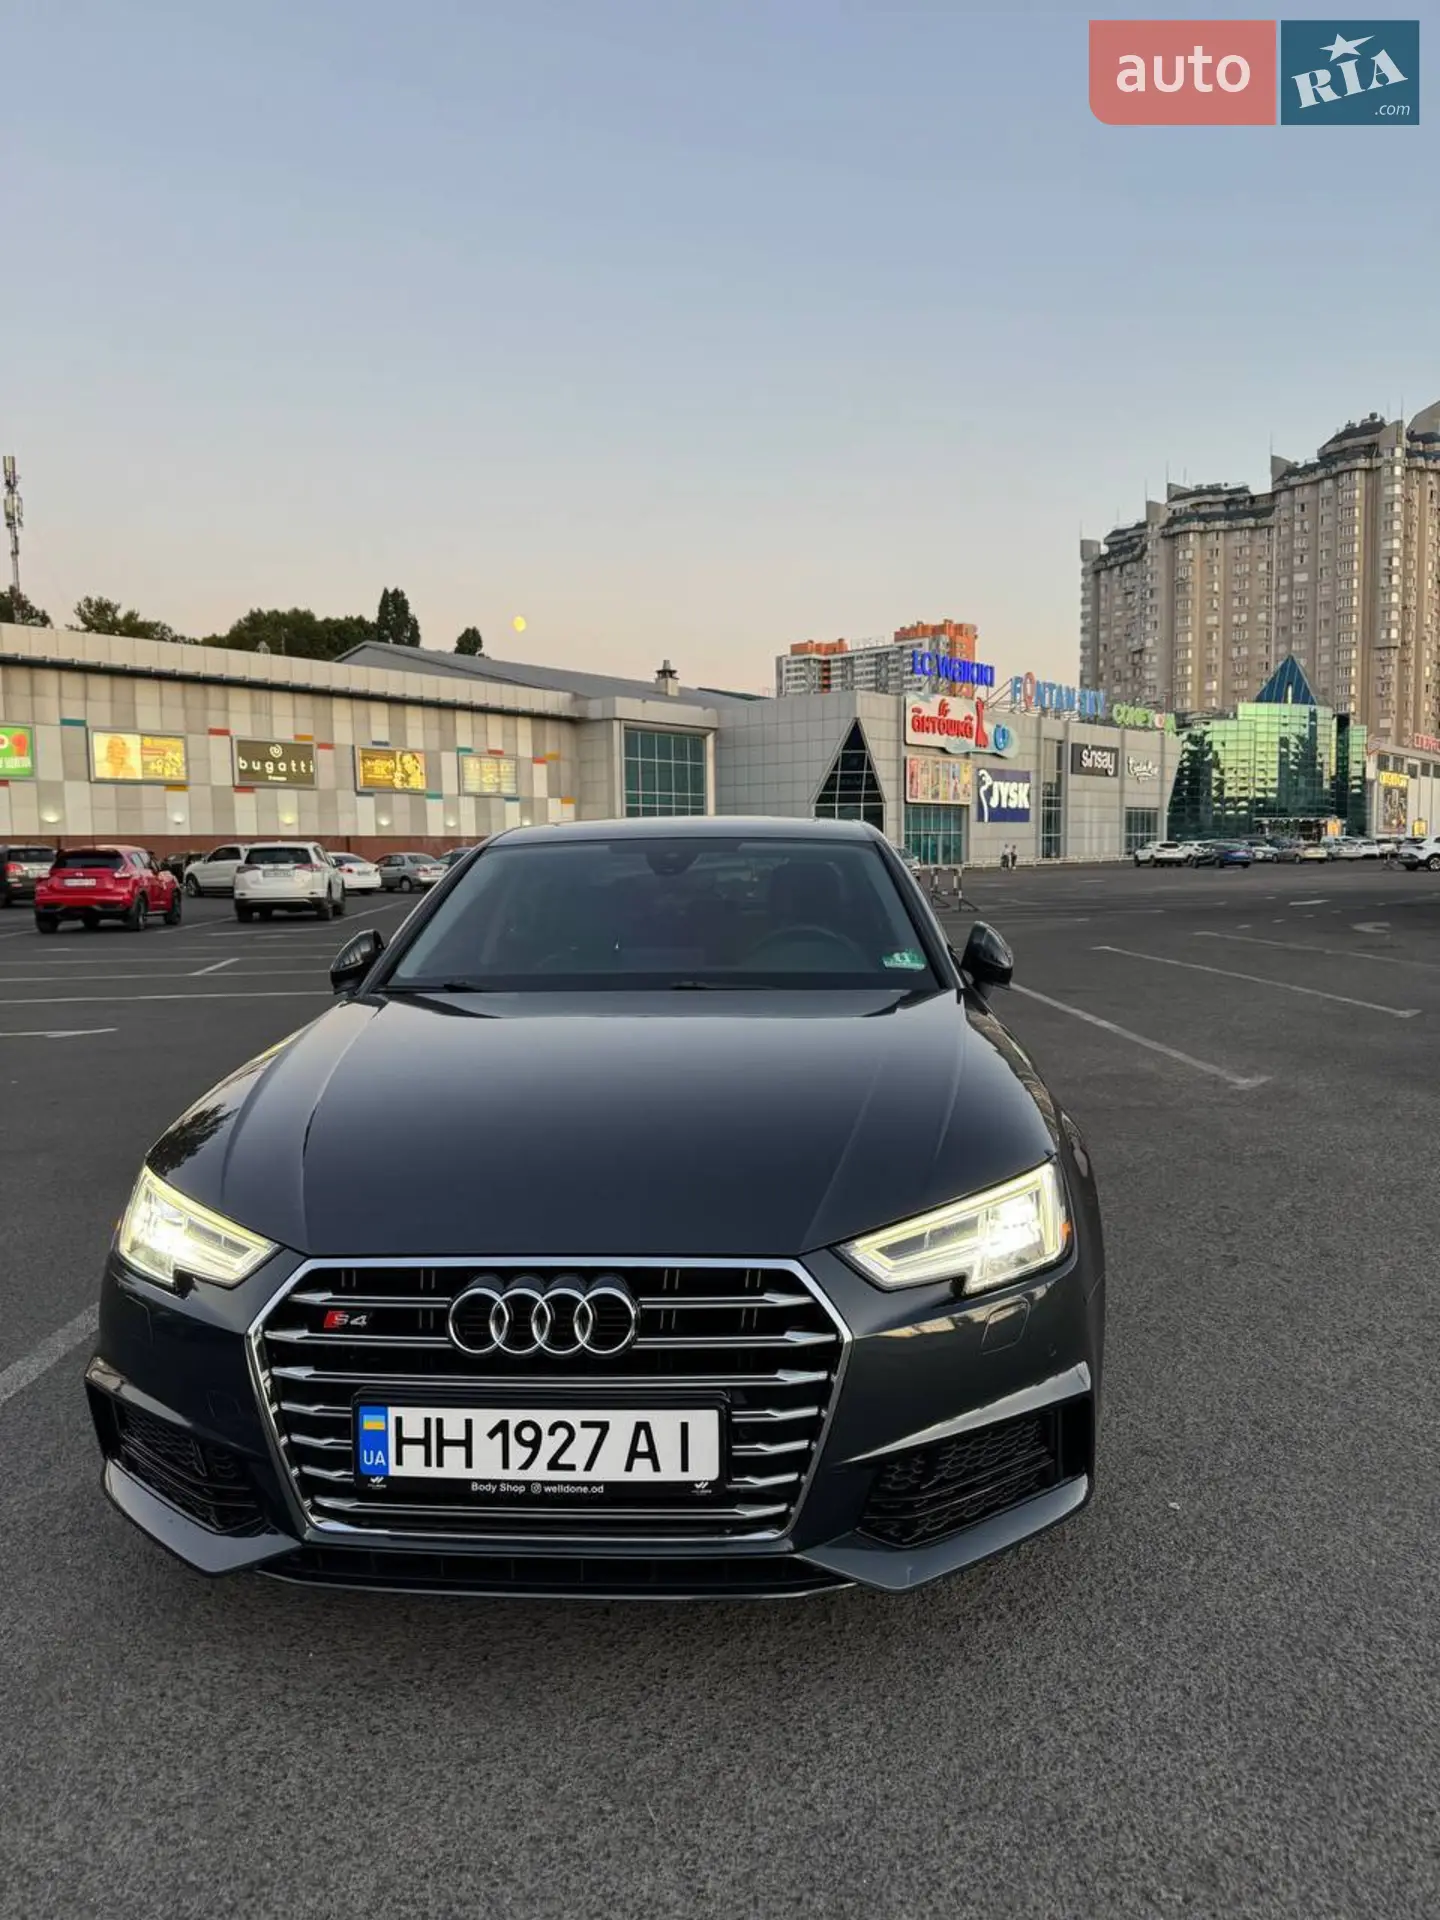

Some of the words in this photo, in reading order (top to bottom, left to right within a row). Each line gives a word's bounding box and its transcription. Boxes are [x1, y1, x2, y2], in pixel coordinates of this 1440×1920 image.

[911, 649, 932, 676] LC
[238, 756, 314, 774] bugatti
[1081, 744, 1116, 776] sinsay
[989, 781, 1030, 808] JYSK
[329, 1311, 368, 1327] S4
[395, 1415, 474, 1469] HH
[486, 1419, 610, 1472] 1927
[363, 1450, 387, 1466] UA
[470, 1481, 498, 1494] Body
[499, 1482, 526, 1494] Shop
[543, 1484, 605, 1494] welldone.od
